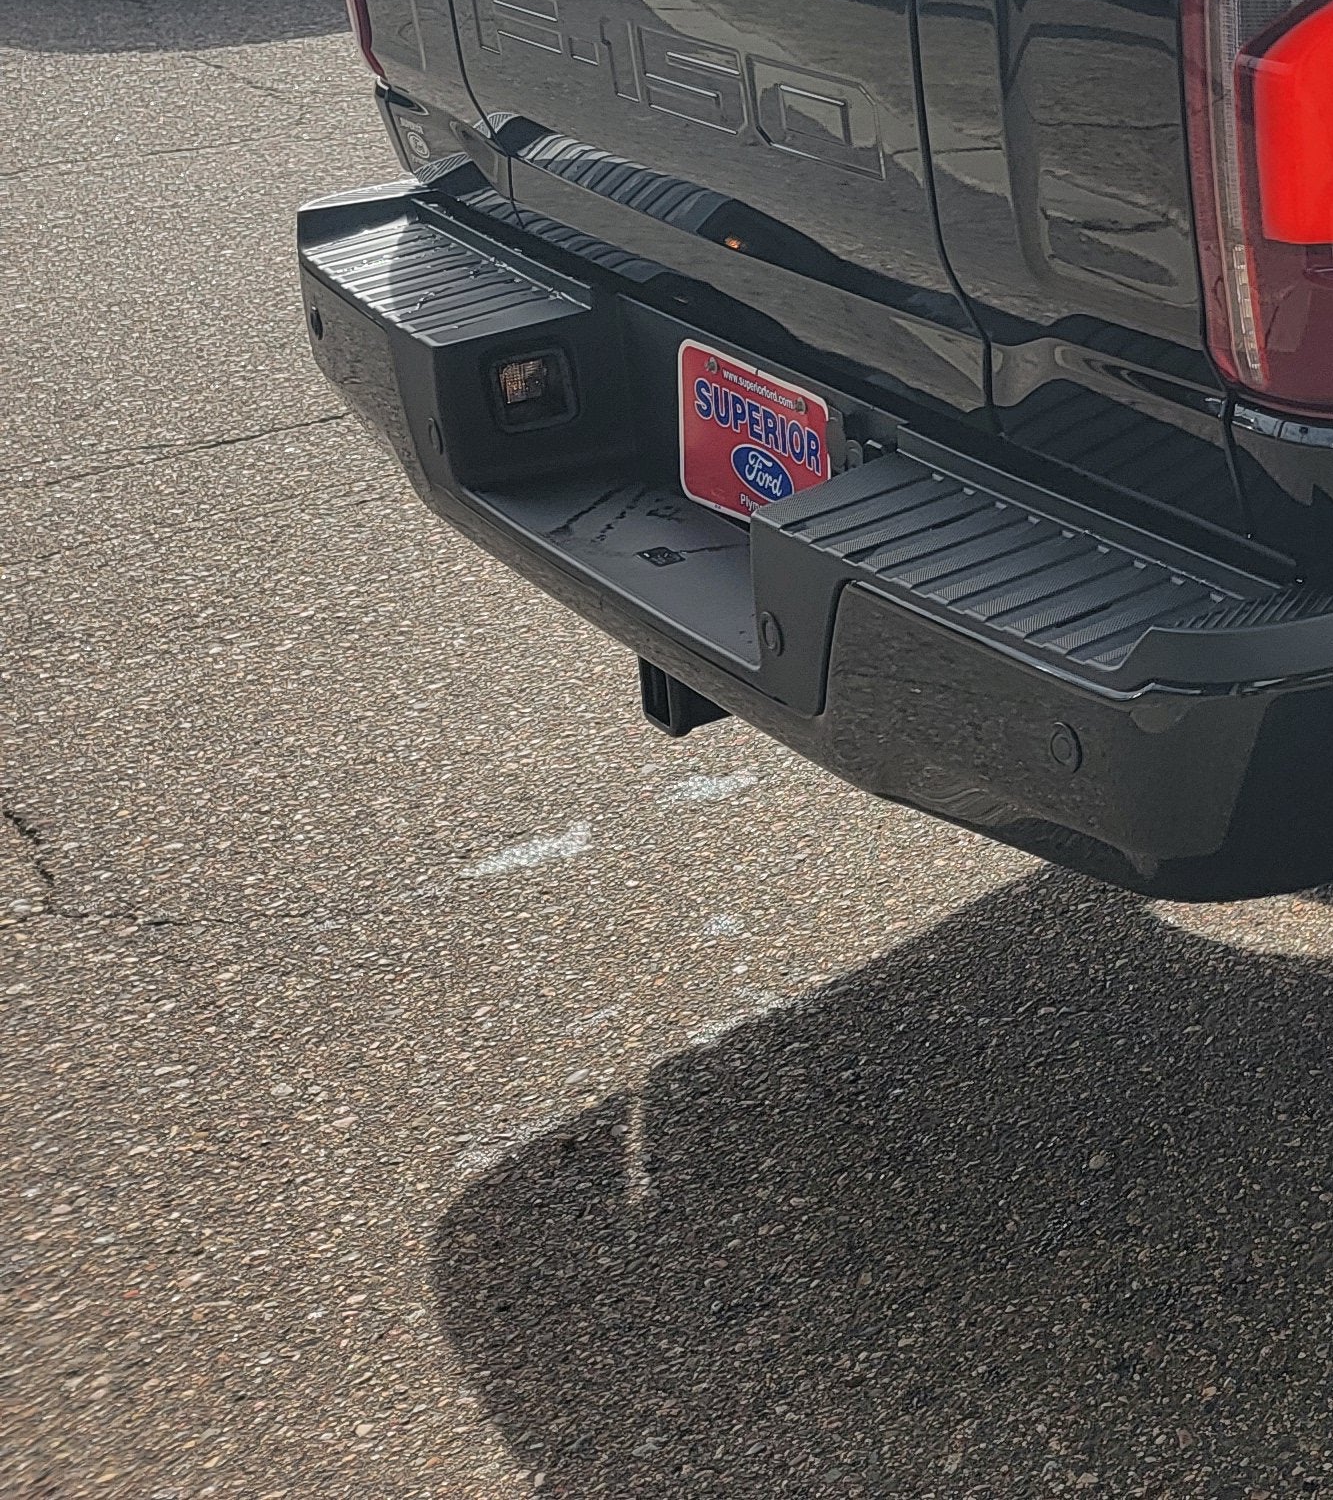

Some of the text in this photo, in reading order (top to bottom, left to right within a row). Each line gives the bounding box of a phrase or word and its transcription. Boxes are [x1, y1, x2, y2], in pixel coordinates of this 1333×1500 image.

[694, 377, 822, 477] SUPERIOR
[744, 451, 783, 497] Ford
[740, 493, 761, 512] Plym
